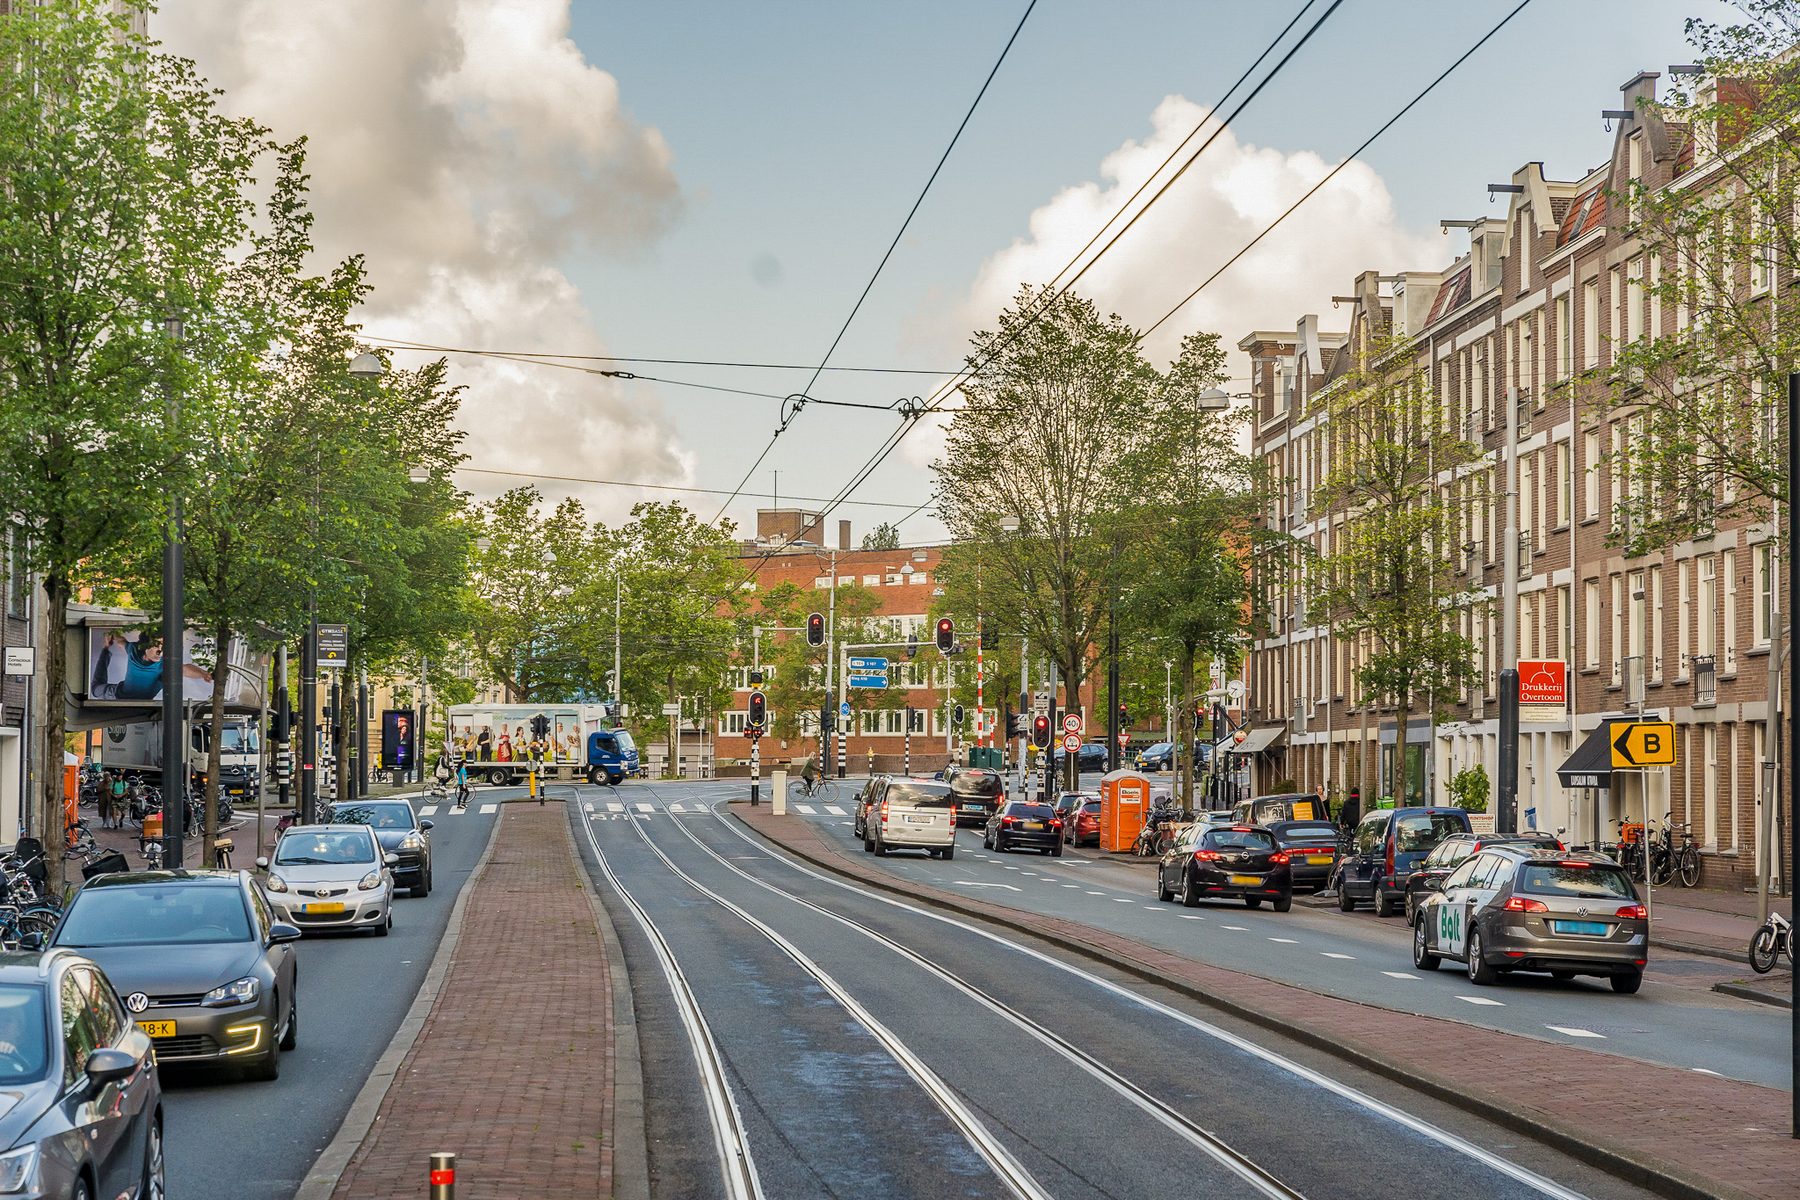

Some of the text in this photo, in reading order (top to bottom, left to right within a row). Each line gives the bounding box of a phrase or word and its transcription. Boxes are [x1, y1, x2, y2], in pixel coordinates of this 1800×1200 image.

[1521, 682, 1563, 693] Drukkerij
[1521, 692, 1563, 701] Overtoom
[1644, 733, 1662, 755] B
[1441, 905, 1461, 942] Bolt
